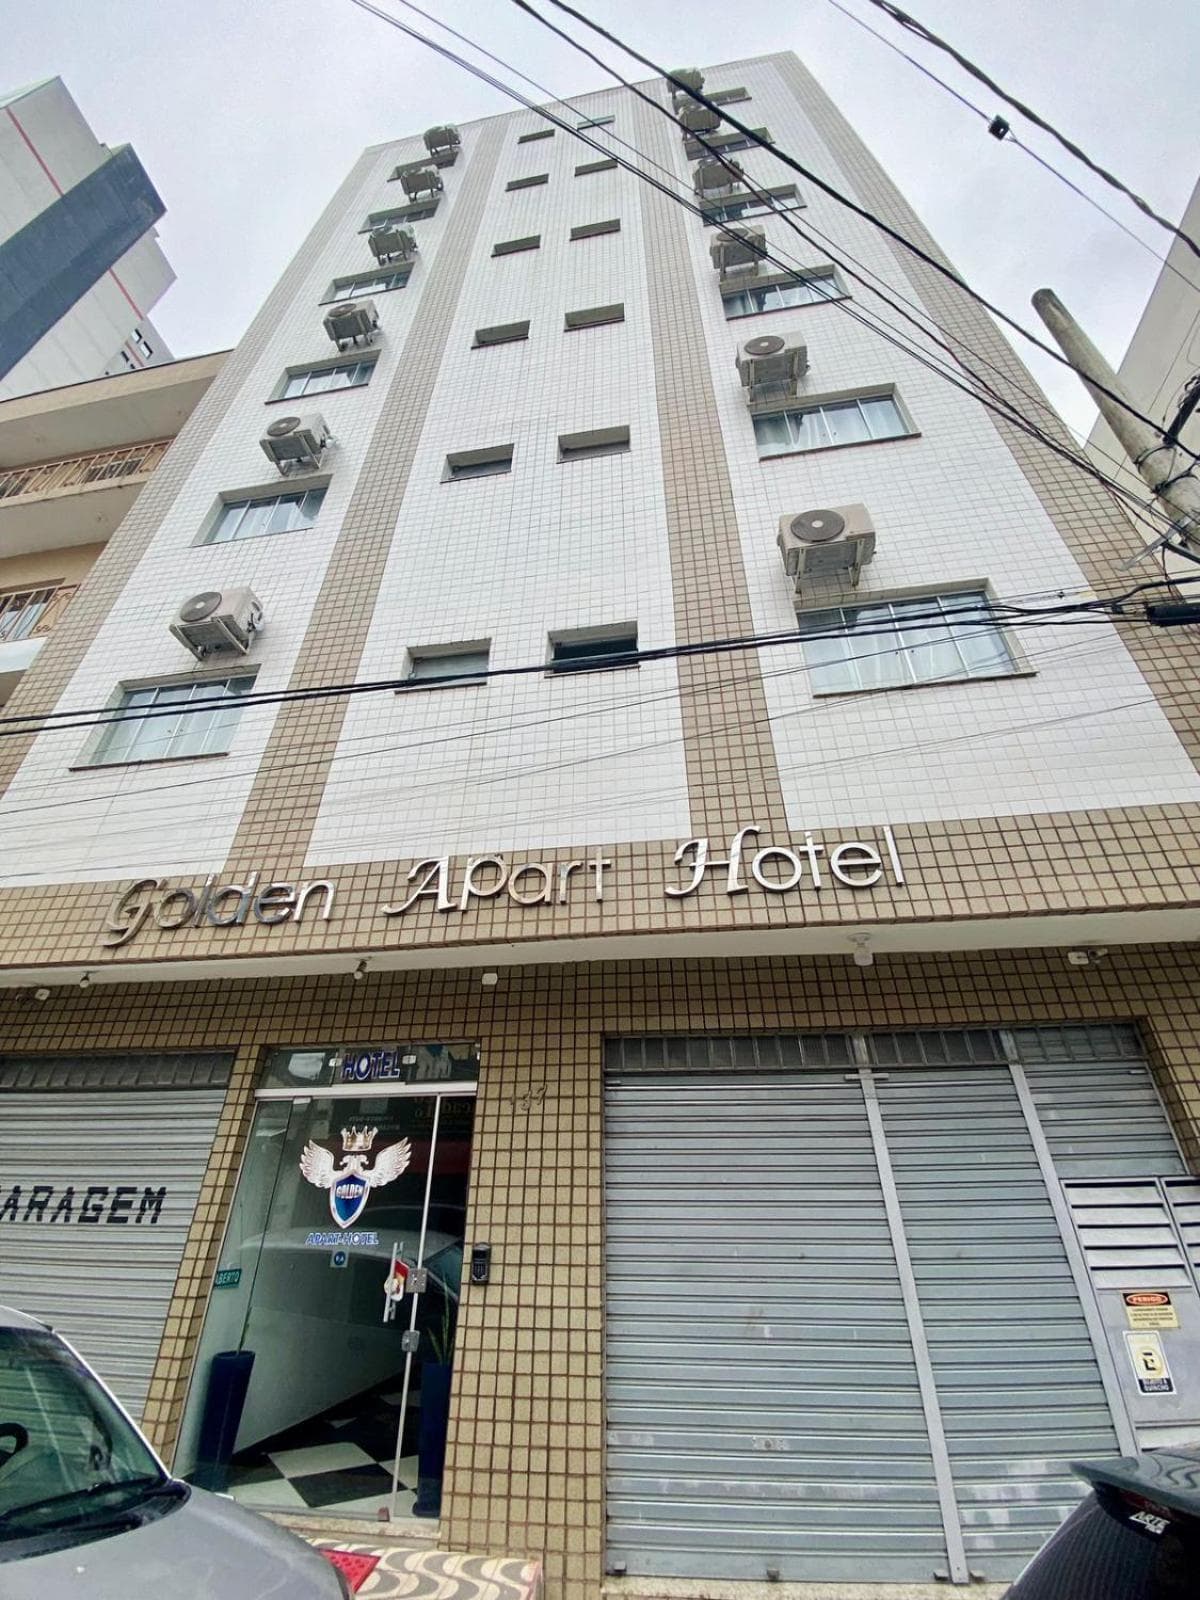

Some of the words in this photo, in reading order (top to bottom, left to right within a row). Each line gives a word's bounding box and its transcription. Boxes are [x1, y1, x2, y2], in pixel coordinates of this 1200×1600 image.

[103, 872, 335, 947] Golden
[381, 846, 611, 914] Apart
[664, 826, 906, 896] Hotel
[341, 1050, 401, 1081] HOTEL
[0, 1185, 167, 1224] ARAGEM
[336, 1183, 365, 1199] GOLDEN
